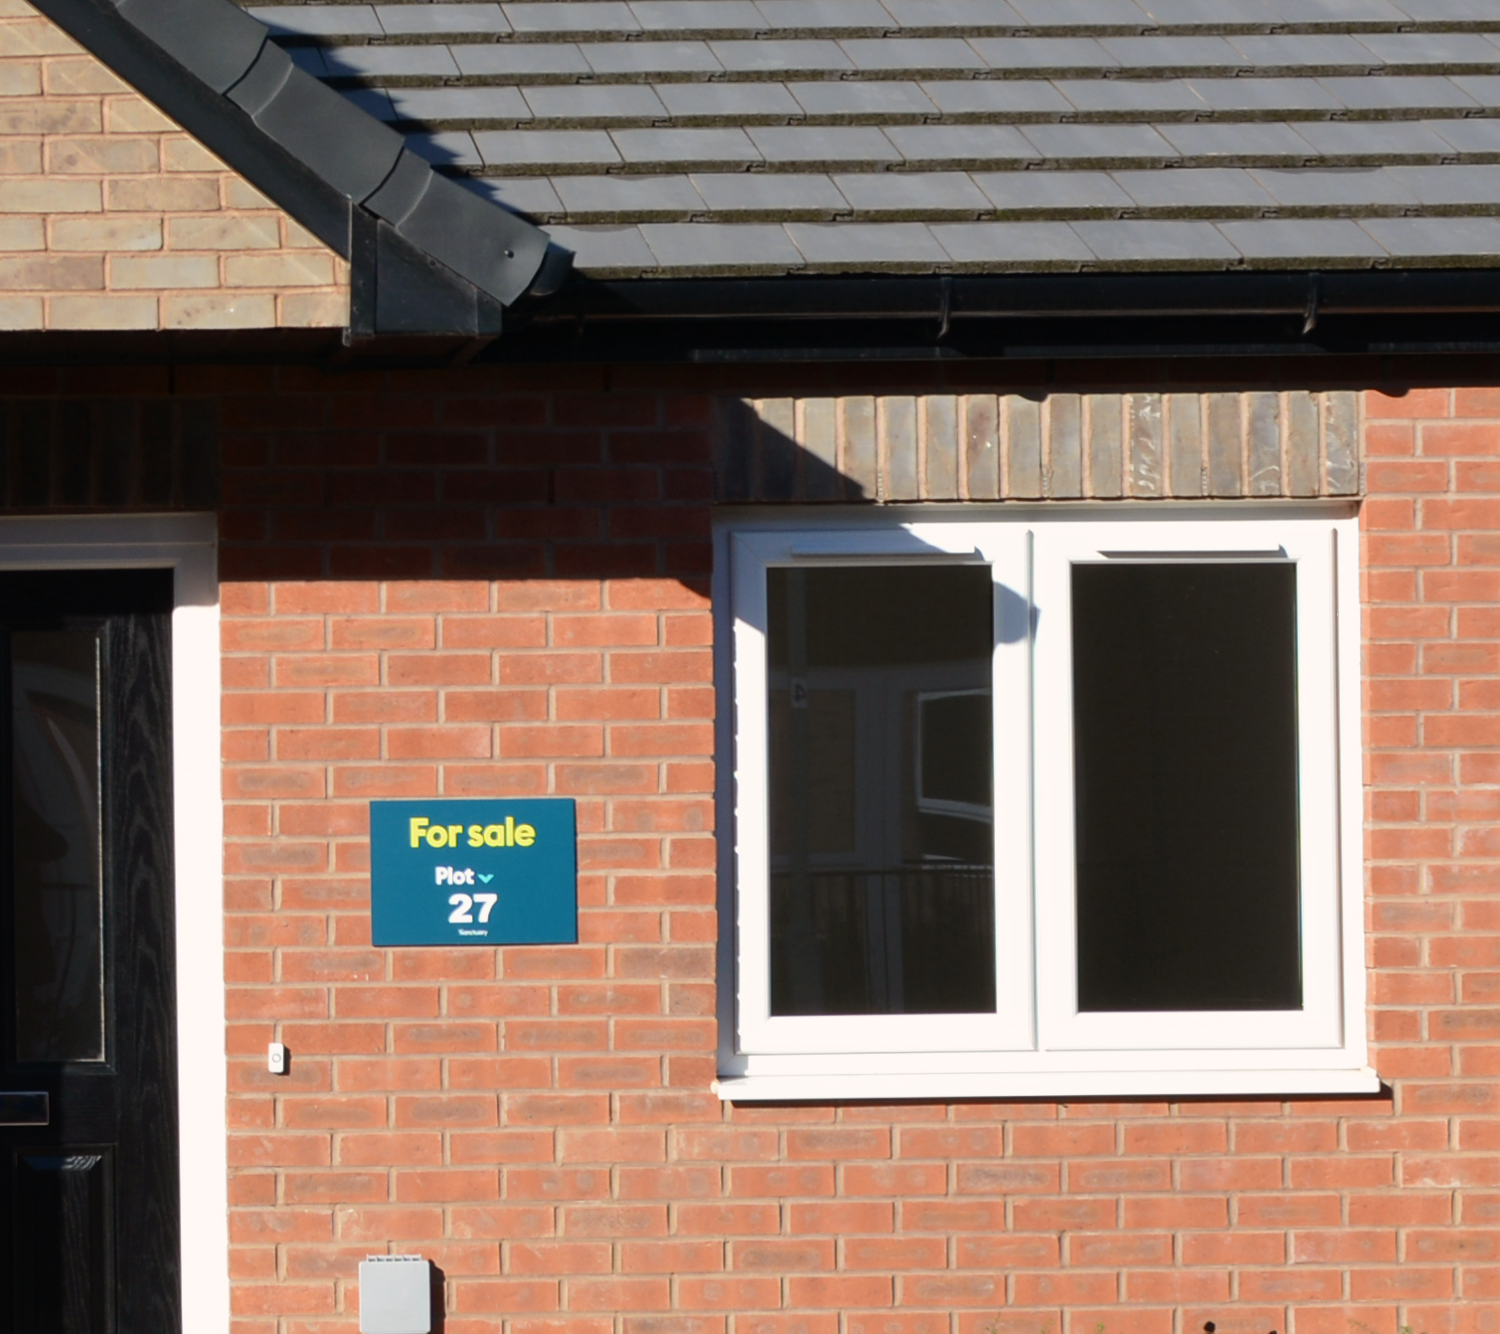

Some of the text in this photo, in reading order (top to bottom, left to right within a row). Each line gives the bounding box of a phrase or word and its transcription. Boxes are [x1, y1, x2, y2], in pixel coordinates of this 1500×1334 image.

[409, 816, 536, 848] For sale
[435, 866, 475, 885] Plot
[448, 893, 498, 923] 27
